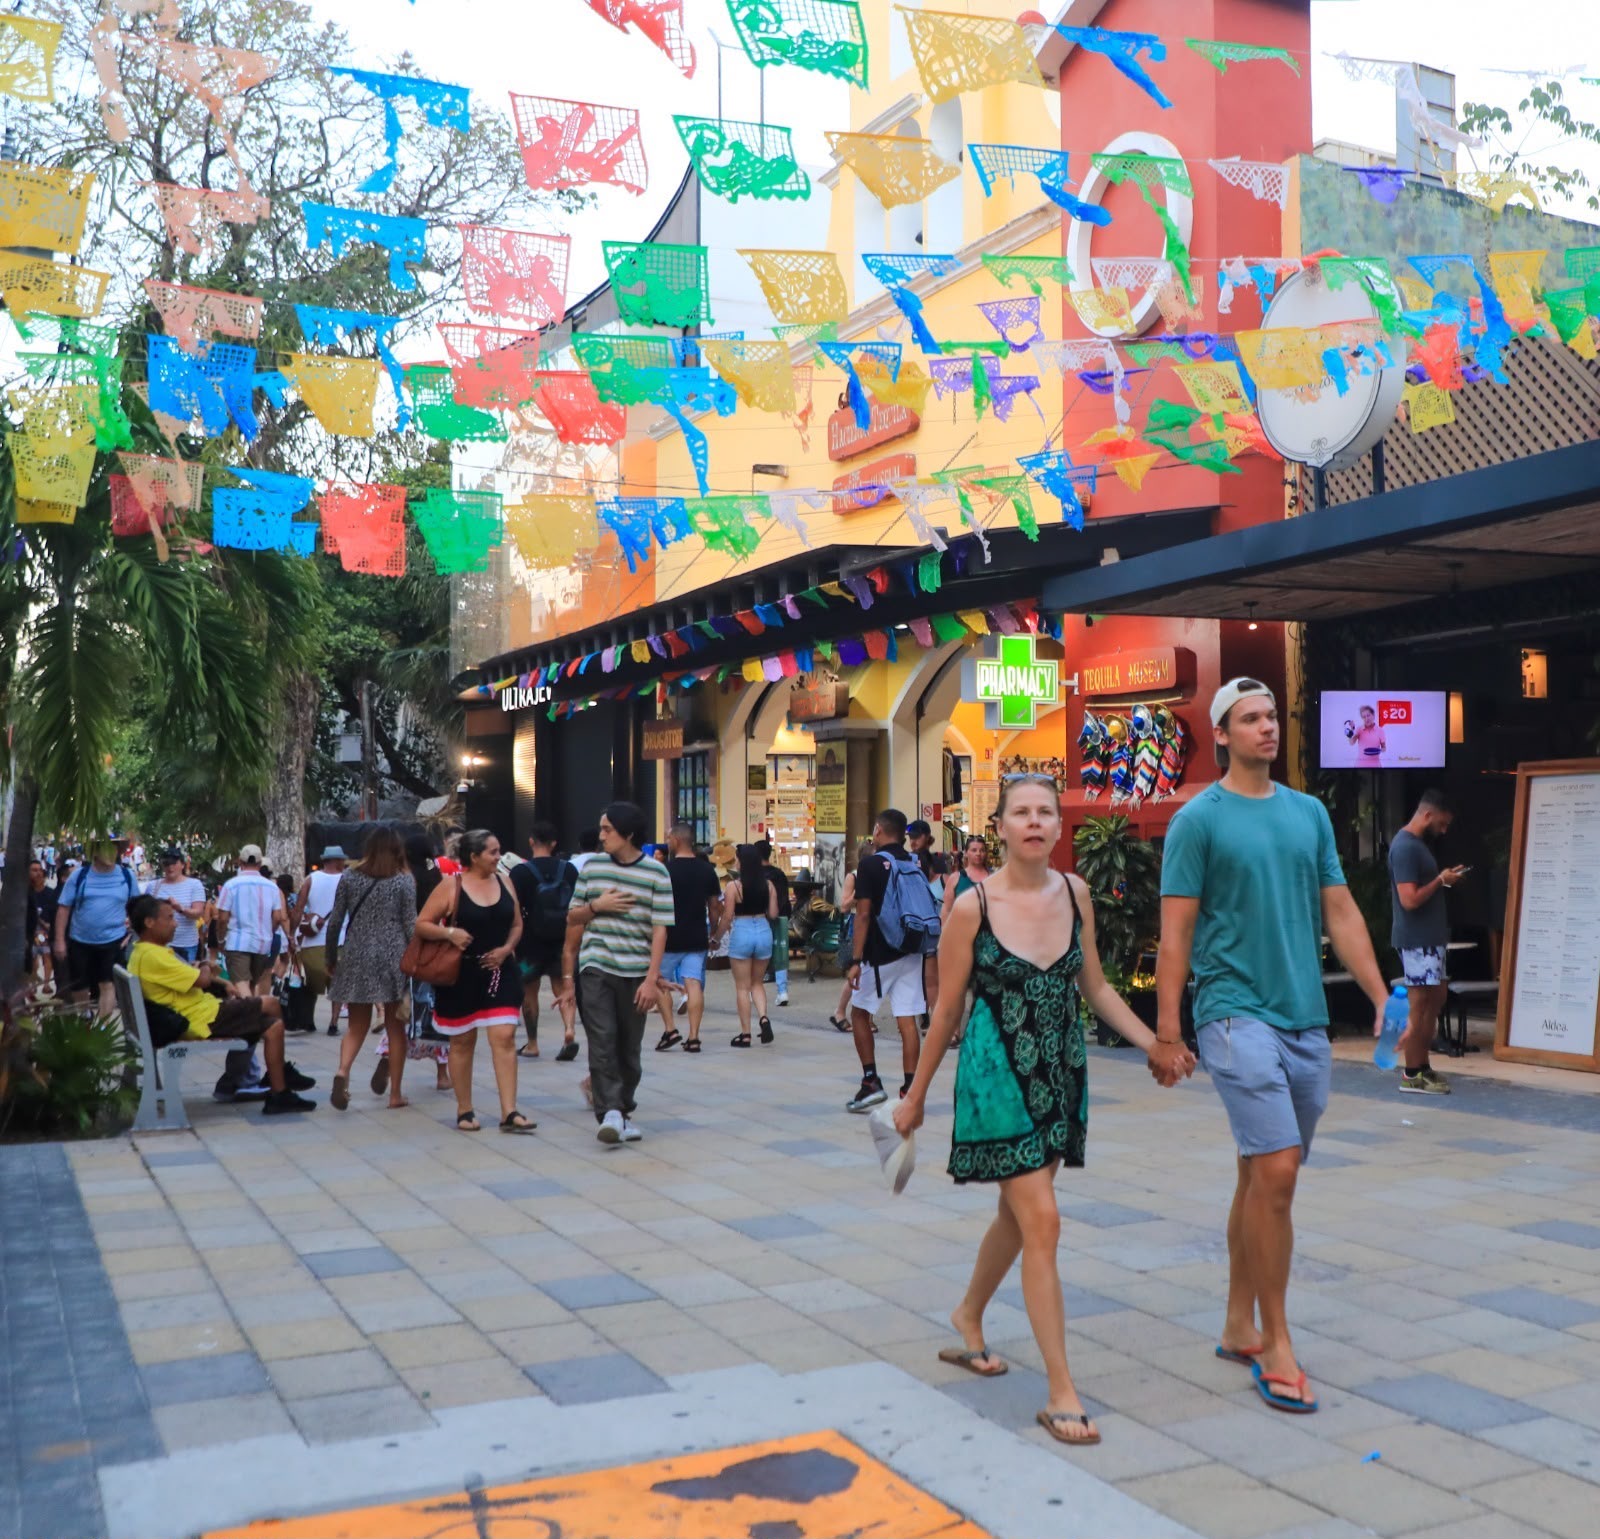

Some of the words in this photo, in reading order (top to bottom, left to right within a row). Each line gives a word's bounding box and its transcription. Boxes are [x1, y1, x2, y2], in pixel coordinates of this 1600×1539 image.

[980, 665, 1052, 697] PHARMACY
[1084, 665, 1121, 692] TEQUILA
[1128, 658, 1169, 686] MUSEUM
